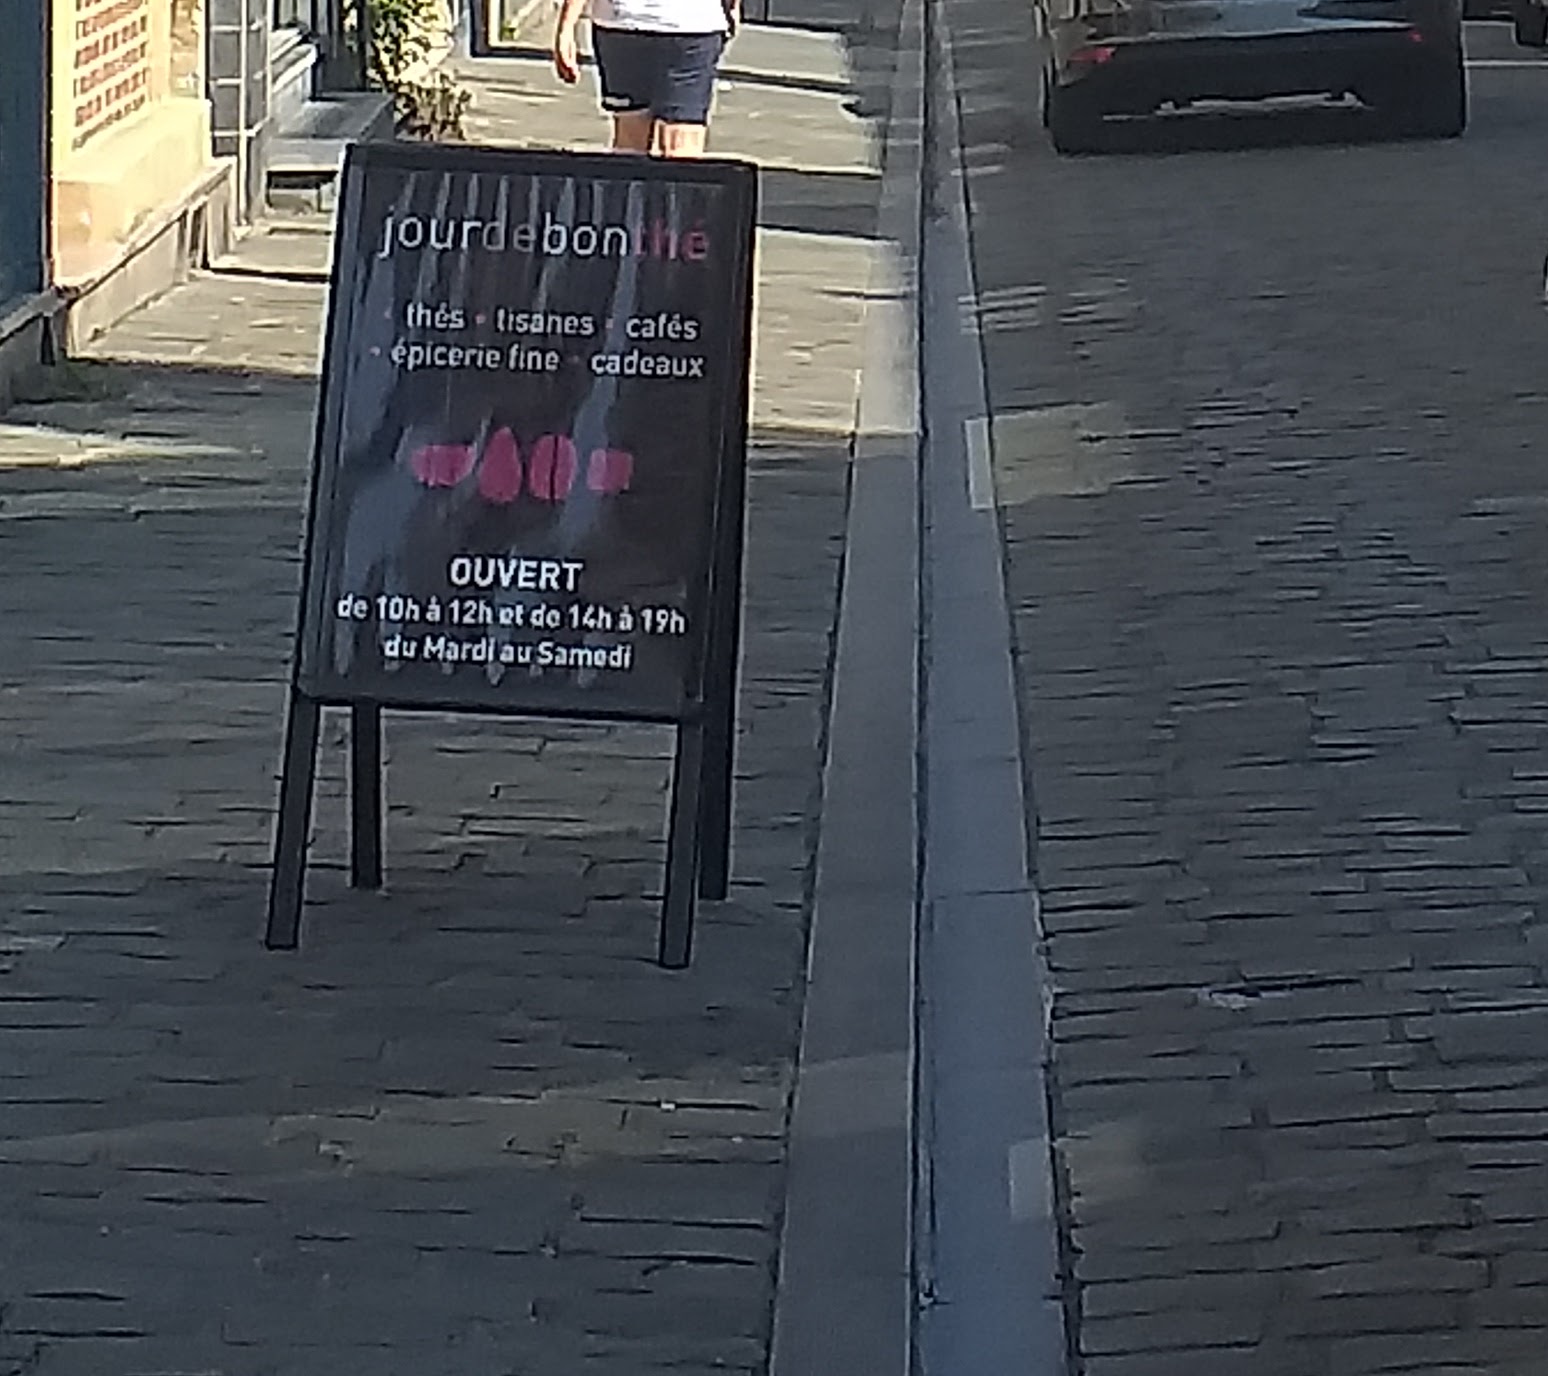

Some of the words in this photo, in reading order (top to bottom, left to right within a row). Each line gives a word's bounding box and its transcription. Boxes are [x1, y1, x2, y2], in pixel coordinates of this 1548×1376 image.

[406, 302, 465, 329] thés
[496, 308, 595, 336] tisanes
[626, 313, 699, 340] cafés
[391, 337, 501, 371] épicerie
[509, 343, 560, 370] fine
[591, 349, 704, 377] cadeaux
[450, 557, 584, 592] OUVERT
[337, 593, 369, 619] de
[376, 595, 420, 622] 10h
[425, 595, 441, 622] à
[449, 599, 493, 625] 12h
[499, 603, 524, 626] et
[568, 603, 612, 629] 14h
[618, 604, 634, 631] à
[640, 608, 685, 634] 19h
[384, 634, 417, 658] du
[423, 634, 495, 662] Mardi
[500, 643, 531, 664] au
[537, 641, 632, 669] Samedi
